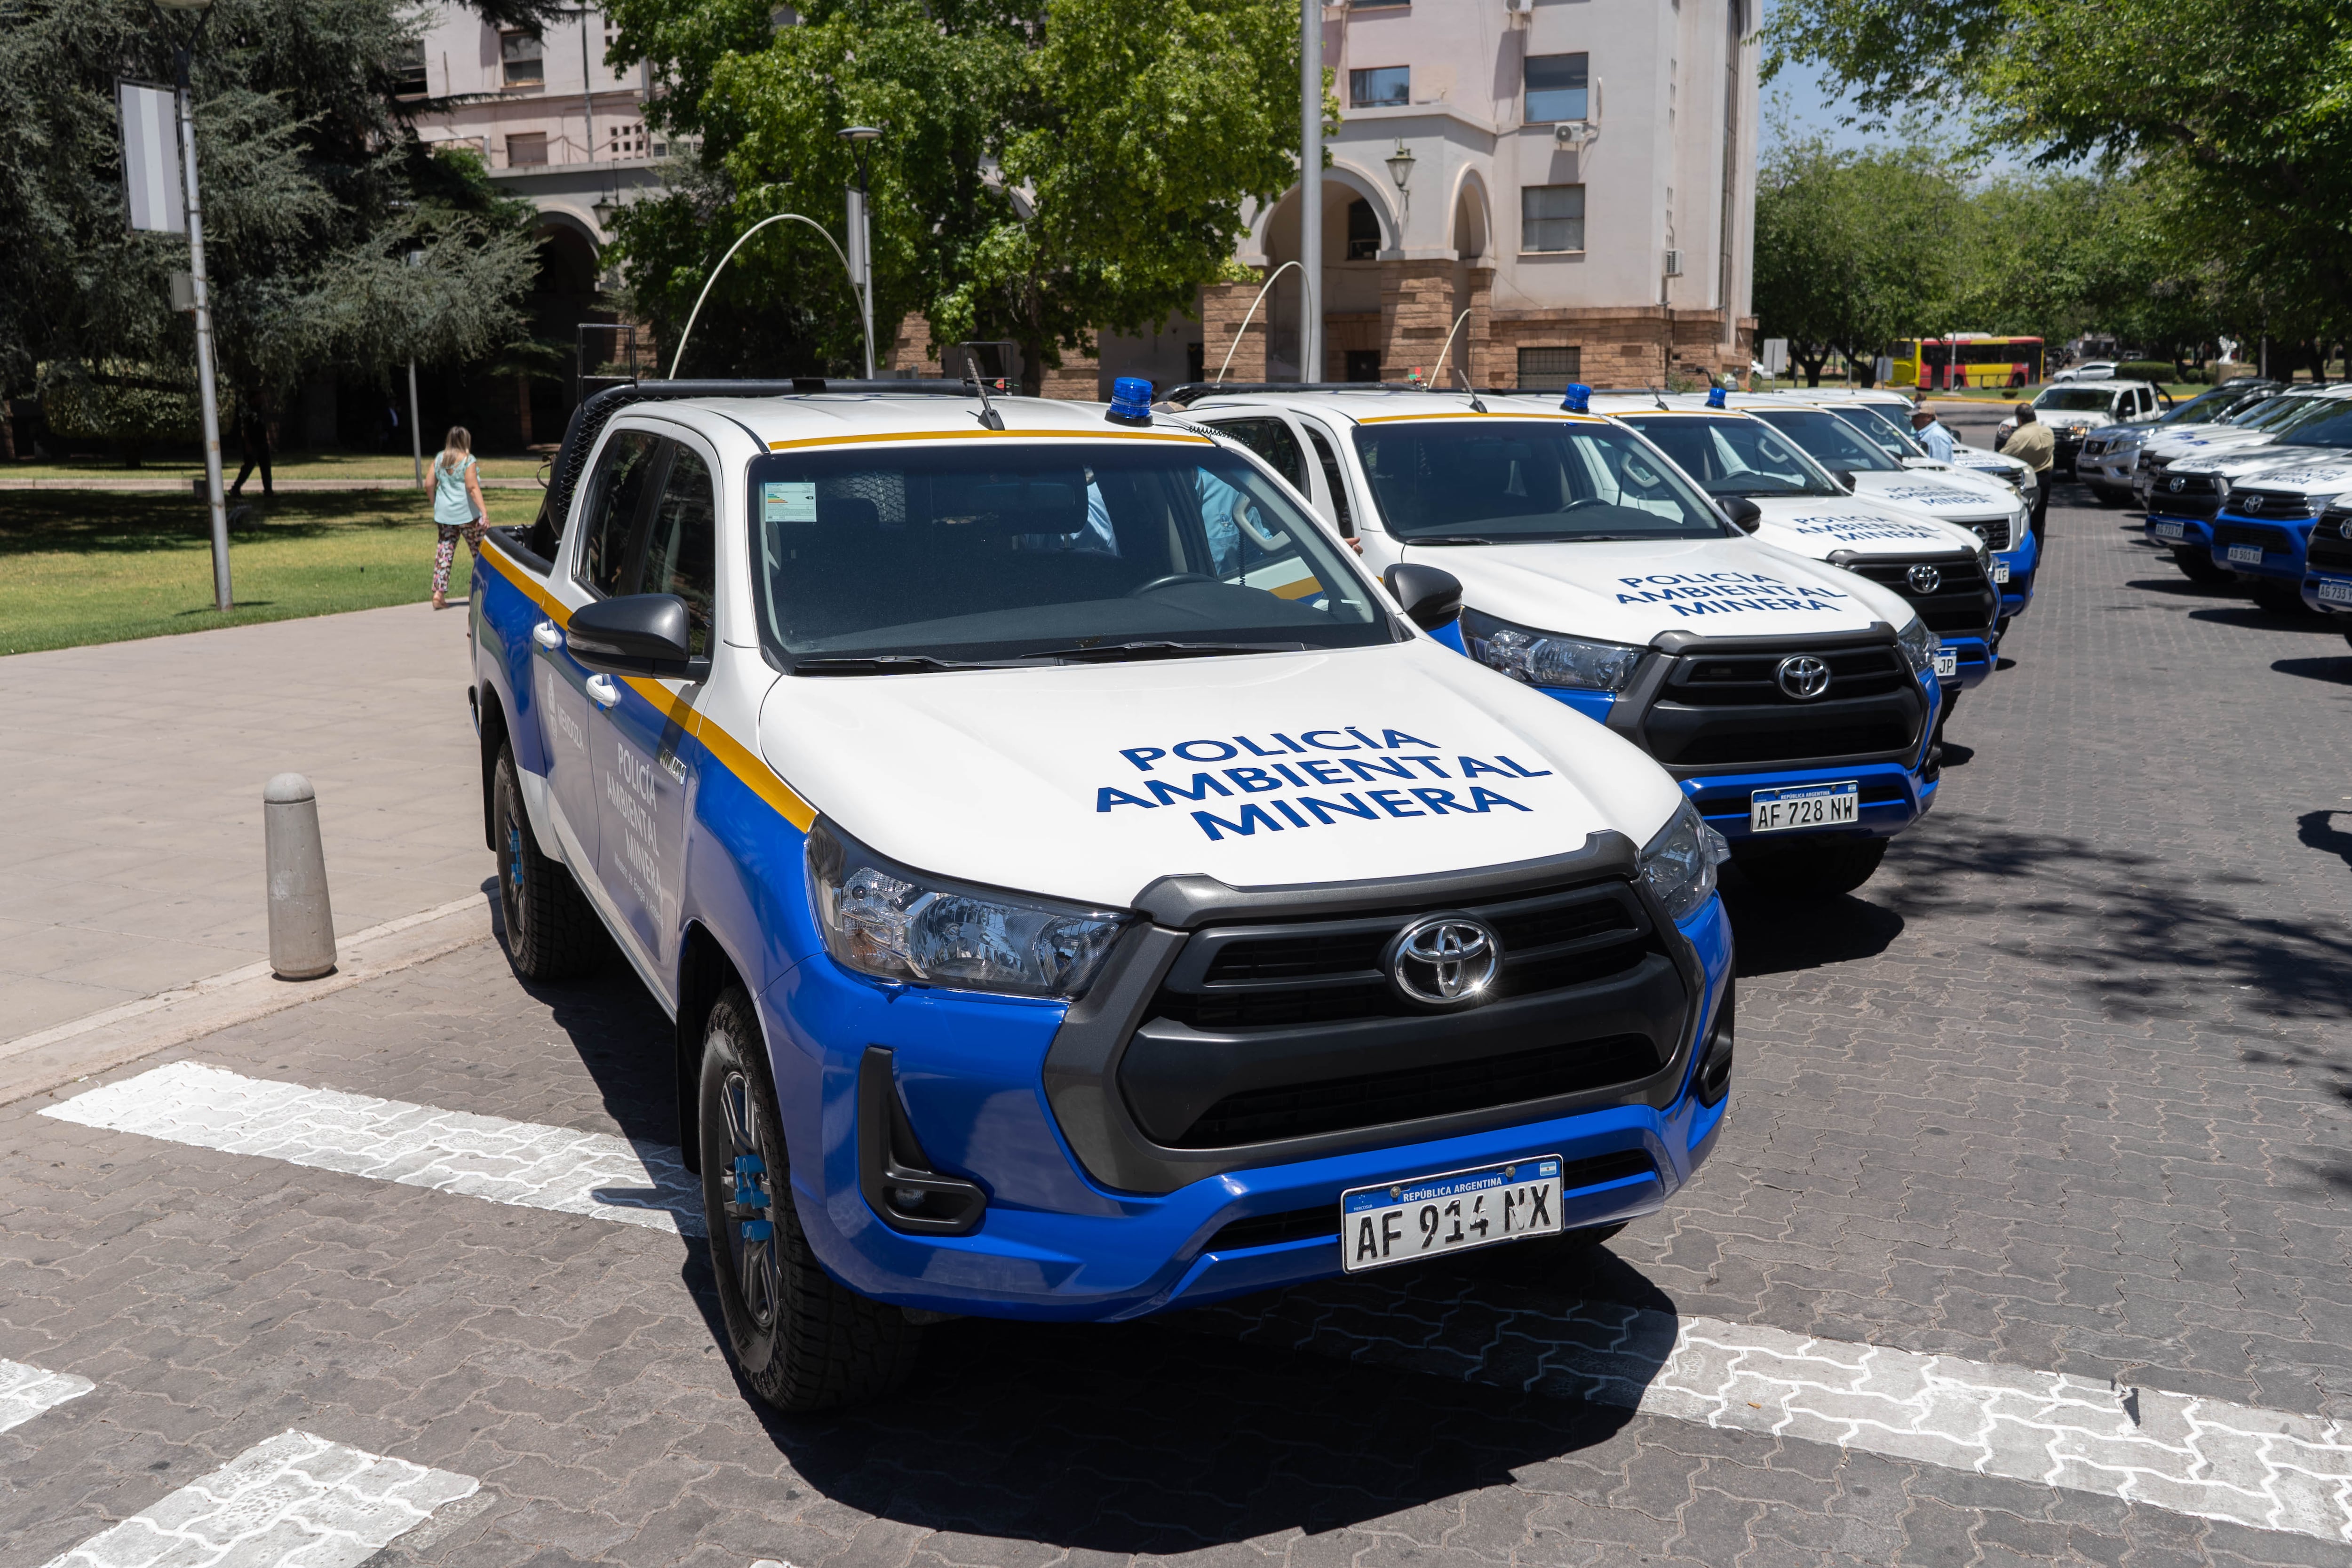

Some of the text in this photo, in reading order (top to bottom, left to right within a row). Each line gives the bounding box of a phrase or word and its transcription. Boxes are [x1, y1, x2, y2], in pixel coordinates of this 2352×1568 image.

[1796, 522, 1941, 534] AMBIENTAL
[1833, 531, 1941, 541] MINERA
[1616, 585, 1848, 604] AMBIENTAL
[1618, 572, 1786, 588] POLICÍA
[2320, 586, 2330, 597] AG
[2332, 587, 2346, 599] 733
[1669, 598, 1843, 617] MINERA
[1939, 659, 1953, 673] JP
[557, 703, 585, 753] MENDOZA
[1118, 726, 1441, 772] POLICÍA
[618, 742, 657, 812] POLICÍA
[1097, 756, 1553, 812] AMBIENTAL
[607, 771, 660, 858] AMBIENTAL
[1190, 786, 1534, 841] MINERA
[1757, 795, 1853, 829] AF 728 NW
[625, 828, 663, 903] MINERA
[1403, 1177, 1502, 1202] REPÚBLICA ARGENTINA
[1356, 1183, 1552, 1262] AF 914 NX
